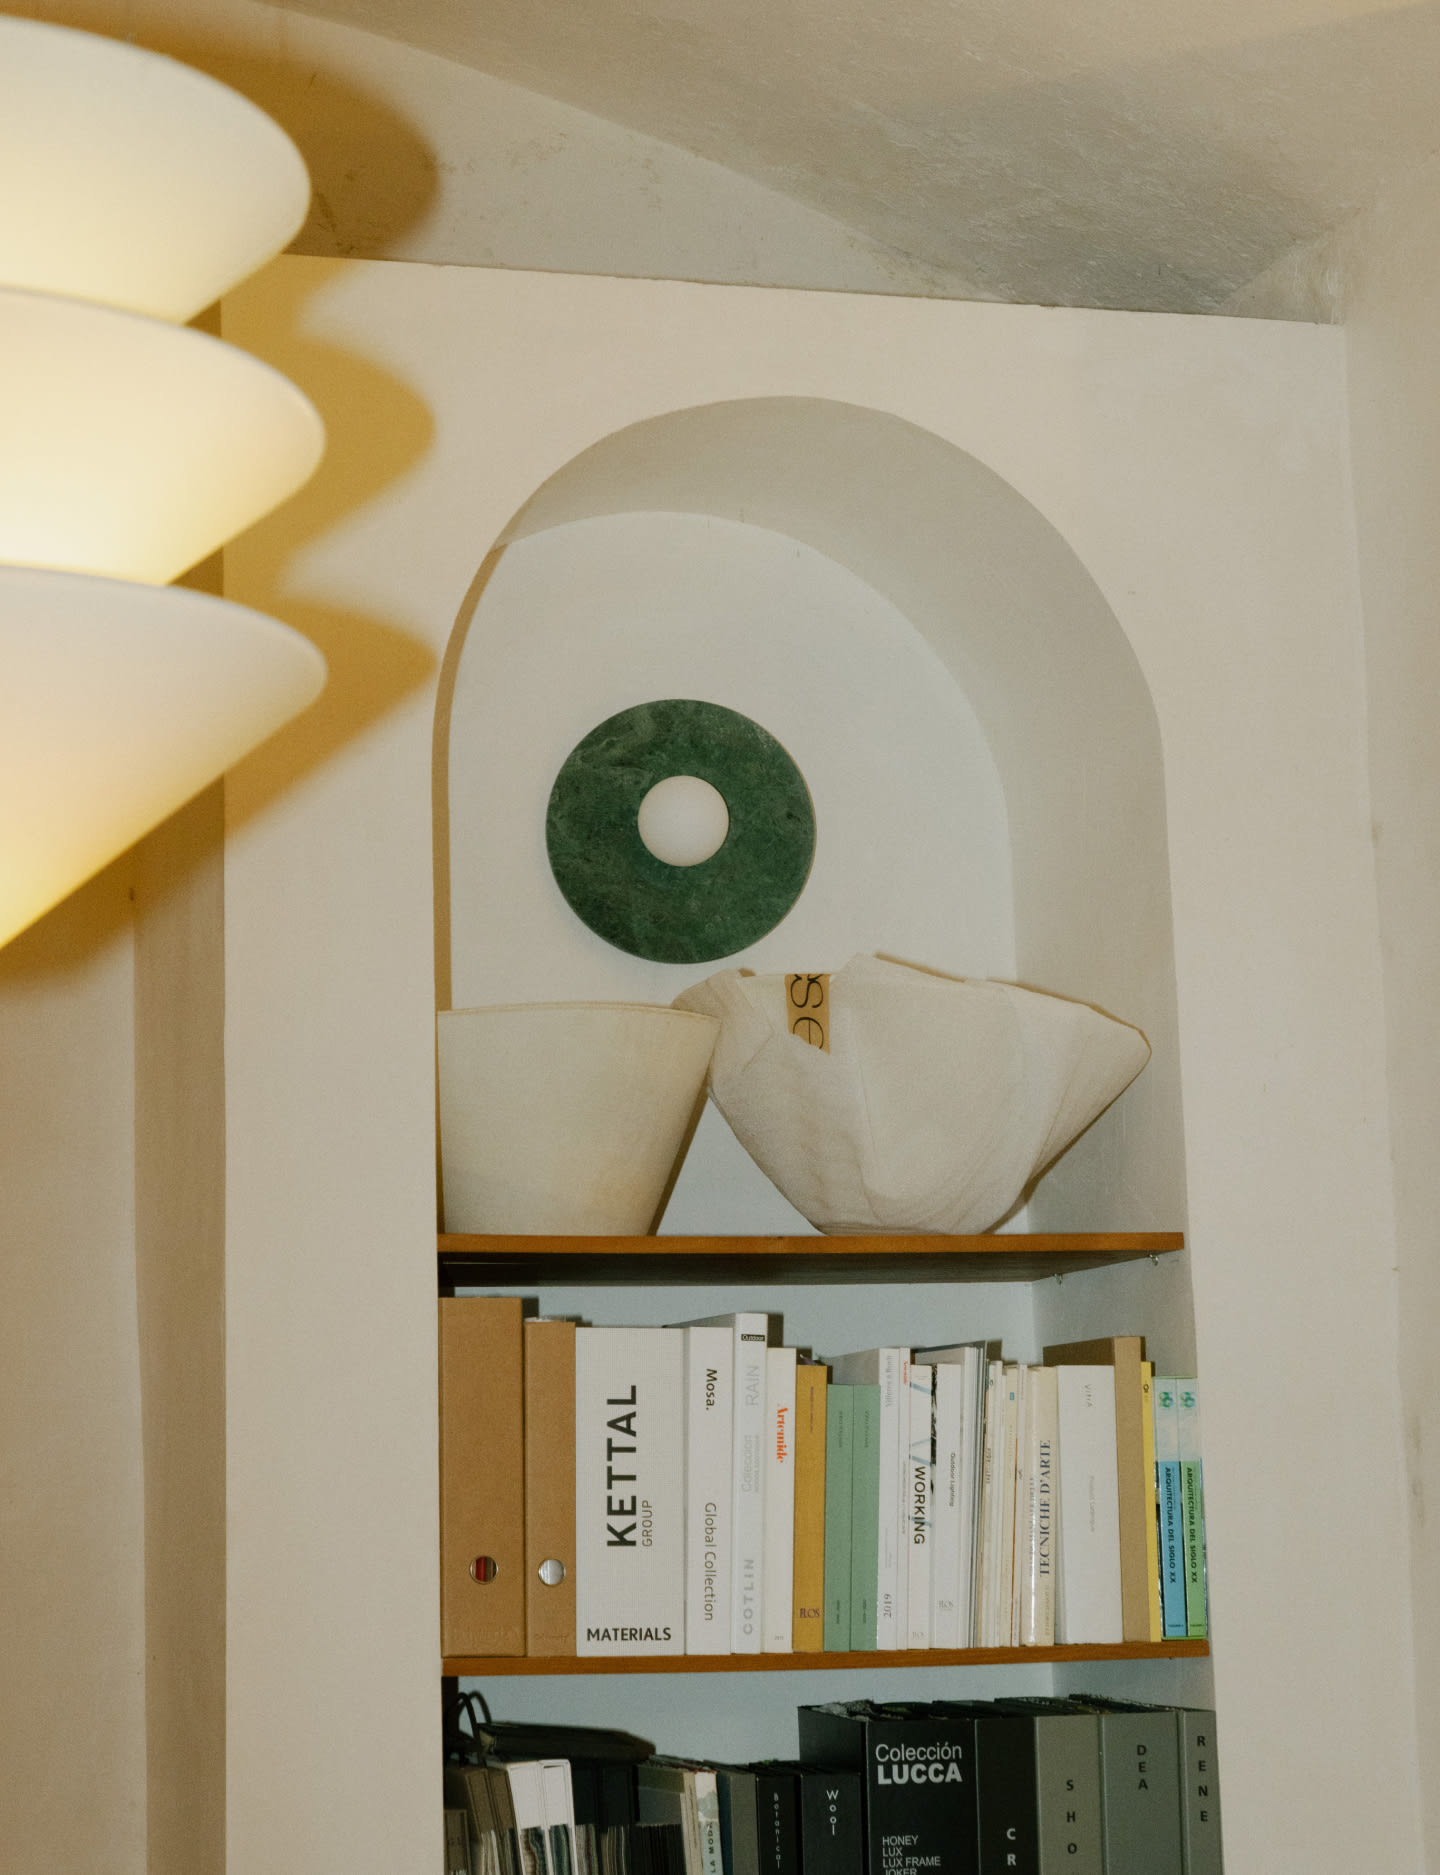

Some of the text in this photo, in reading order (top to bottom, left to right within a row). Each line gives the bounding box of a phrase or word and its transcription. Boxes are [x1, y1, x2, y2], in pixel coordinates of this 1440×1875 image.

[706, 1369, 717, 1410] Mosa.
[745, 1365, 760, 1408] RAIN
[777, 1403, 788, 1463] Artemide
[607, 1385, 636, 1546] KETTAL
[1039, 1440, 1050, 1494] D'ARTE
[914, 1466, 926, 1544] WORKING
[1186, 1467, 1195, 1526] ARQUITECTURA
[642, 1500, 652, 1547] GROUP
[1039, 1498, 1050, 1577] TECNICHE
[1164, 1467, 1177, 1583] ARQUITECTURA DEL SIGLO XX
[704, 1503, 717, 1620] Global Collection
[1189, 1544, 1198, 1568] SIGLO
[1191, 1571, 1198, 1583] XX
[743, 1560, 754, 1635] COTLIN
[883, 1593, 892, 1619] 2019
[587, 1627, 671, 1641] MATERIALS
[875, 1741, 963, 1761] Colección
[1137, 1745, 1148, 1790] DEA
[877, 1763, 963, 1785] LUCCA
[1197, 1736, 1208, 1822] RENE
[826, 1790, 839, 1835] Wool
[883, 1835, 918, 1846] HONEY
[883, 1847, 902, 1857] LUX
[883, 1856, 940, 1868] LUX FRAME
